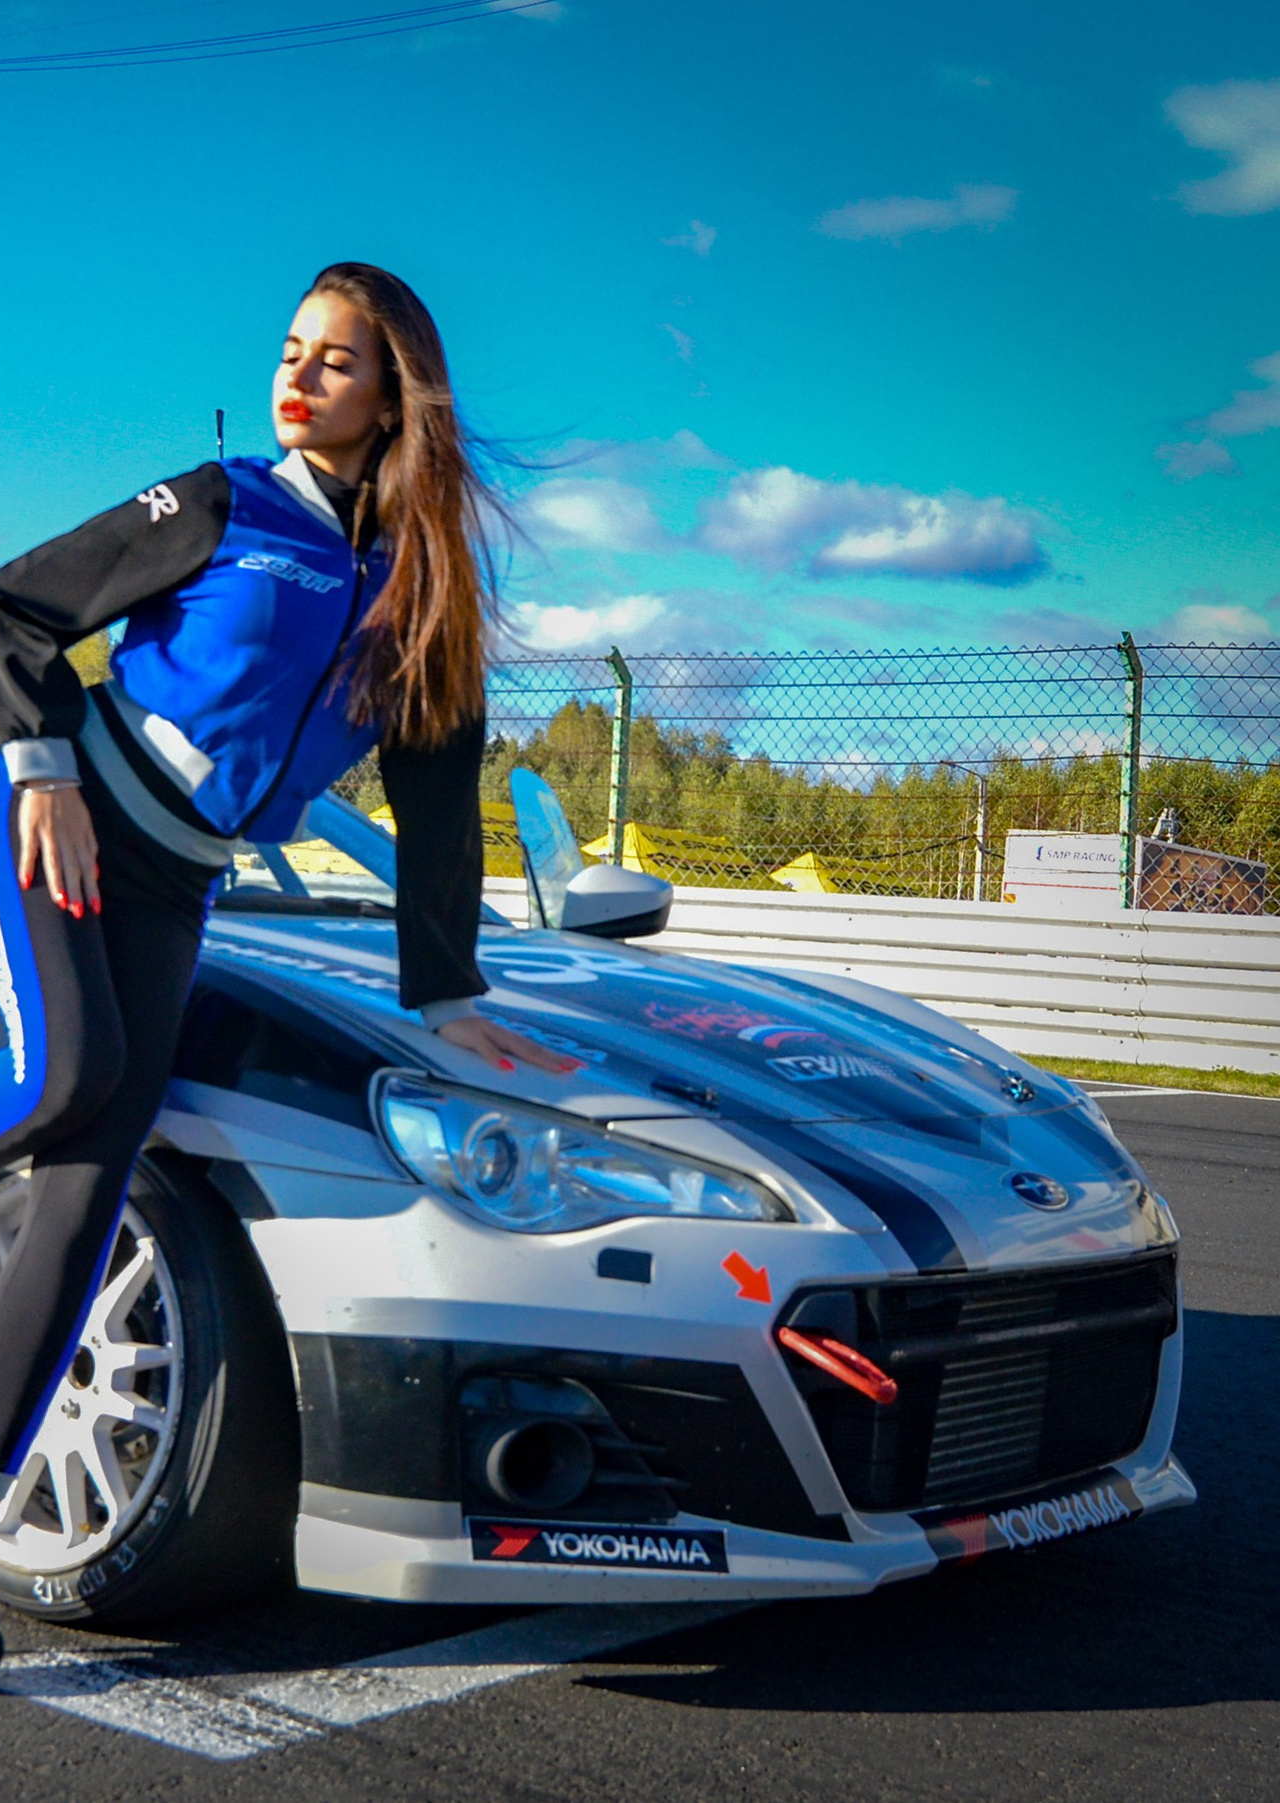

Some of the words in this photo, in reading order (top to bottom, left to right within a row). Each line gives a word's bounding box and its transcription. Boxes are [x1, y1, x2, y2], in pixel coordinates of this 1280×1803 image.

[1047, 850, 1071, 860] SMP
[1073, 851, 1116, 862] RACING
[989, 1485, 1130, 1550] YOKOHAMA
[542, 1532, 711, 1565] YOKOHAMA
